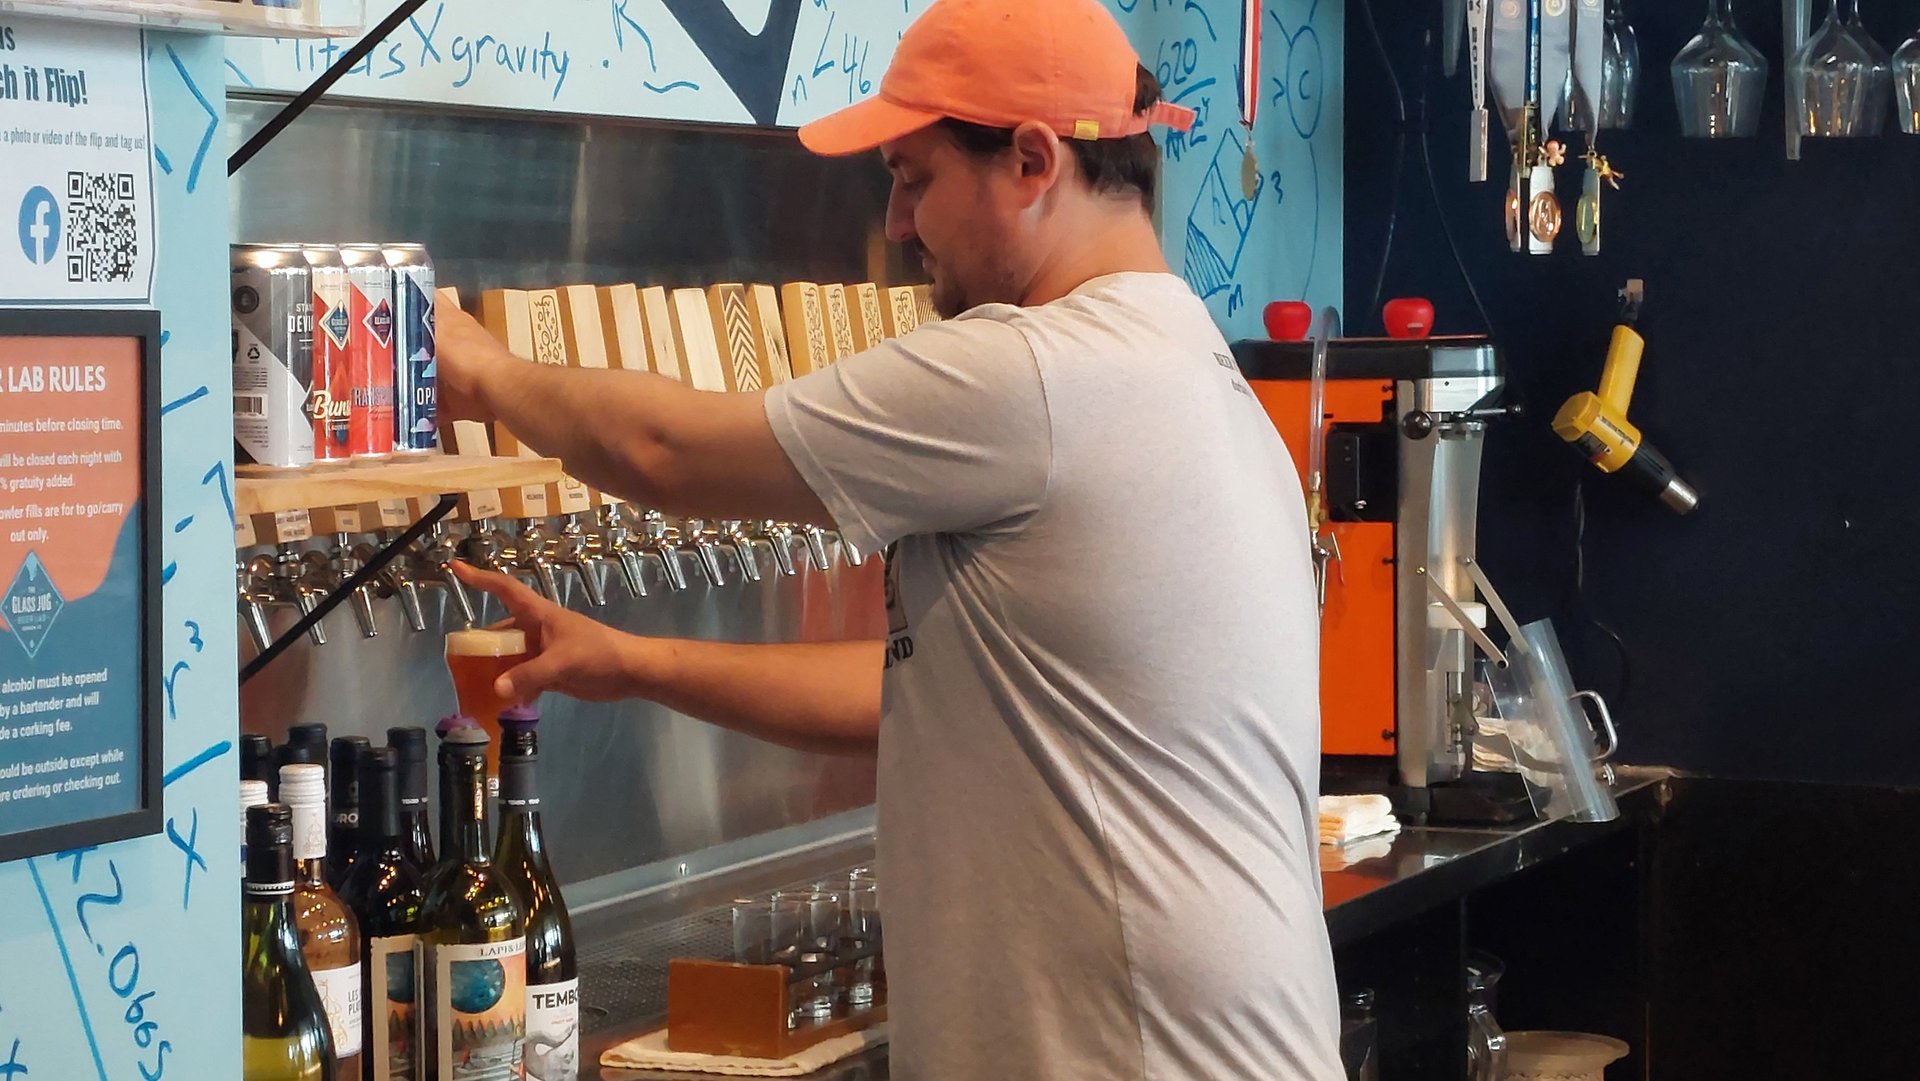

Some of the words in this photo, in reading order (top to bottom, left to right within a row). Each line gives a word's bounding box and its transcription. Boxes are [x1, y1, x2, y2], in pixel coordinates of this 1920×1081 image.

[451, 32, 570, 101] gravity
[23, 65, 40, 102] it
[44, 66, 88, 108] Flip!
[10, 127, 32, 145] photo
[33, 131, 41, 144] or
[41, 129, 63, 145] video
[64, 130, 74, 146] of
[75, 131, 88, 146] the
[104, 132, 119, 149] and
[120, 133, 133, 152] tag
[8, 366, 45, 392] LAB
[48, 365, 106, 393] RULES
[35, 417, 66, 432] before
[67, 417, 100, 435] closing
[101, 417, 124, 431] time.
[12, 452, 25, 467] be
[26, 451, 56, 466] closed
[57, 450, 79, 465] each
[80, 450, 103, 467] night
[103, 449, 122, 463] with
[9, 475, 45, 493] gratuity
[45, 473, 76, 489] added.
[24, 504, 43, 518] fills
[44, 505, 60, 518] are
[60, 502, 75, 516] for
[76, 503, 86, 515] to
[86, 502, 124, 518] go/carry
[10, 529, 26, 543] out
[27, 527, 49, 544] only.
[12, 595, 36, 614] GLASS
[36, 592, 52, 612] JUG
[1, 676, 36, 694] alcohol
[36, 675, 60, 690] must
[61, 673, 74, 687] be
[74, 668, 108, 688] opened
[11, 704, 19, 716] a
[20, 696, 64, 715] bartender
[65, 693, 83, 708] and
[83, 691, 100, 706] will
[12, 727, 19, 739] a
[20, 721, 54, 737] corking
[55, 718, 73, 733] fee.
[21, 762, 34, 776] be
[34, 756, 69, 774] outside
[69, 752, 101, 769] except
[100, 748, 125, 765] while
[12, 783, 52, 799] ordering
[52, 783, 63, 794] or
[63, 774, 104, 793] checking
[104, 772, 122, 786] out.
[348, 988, 359, 1002] LES
